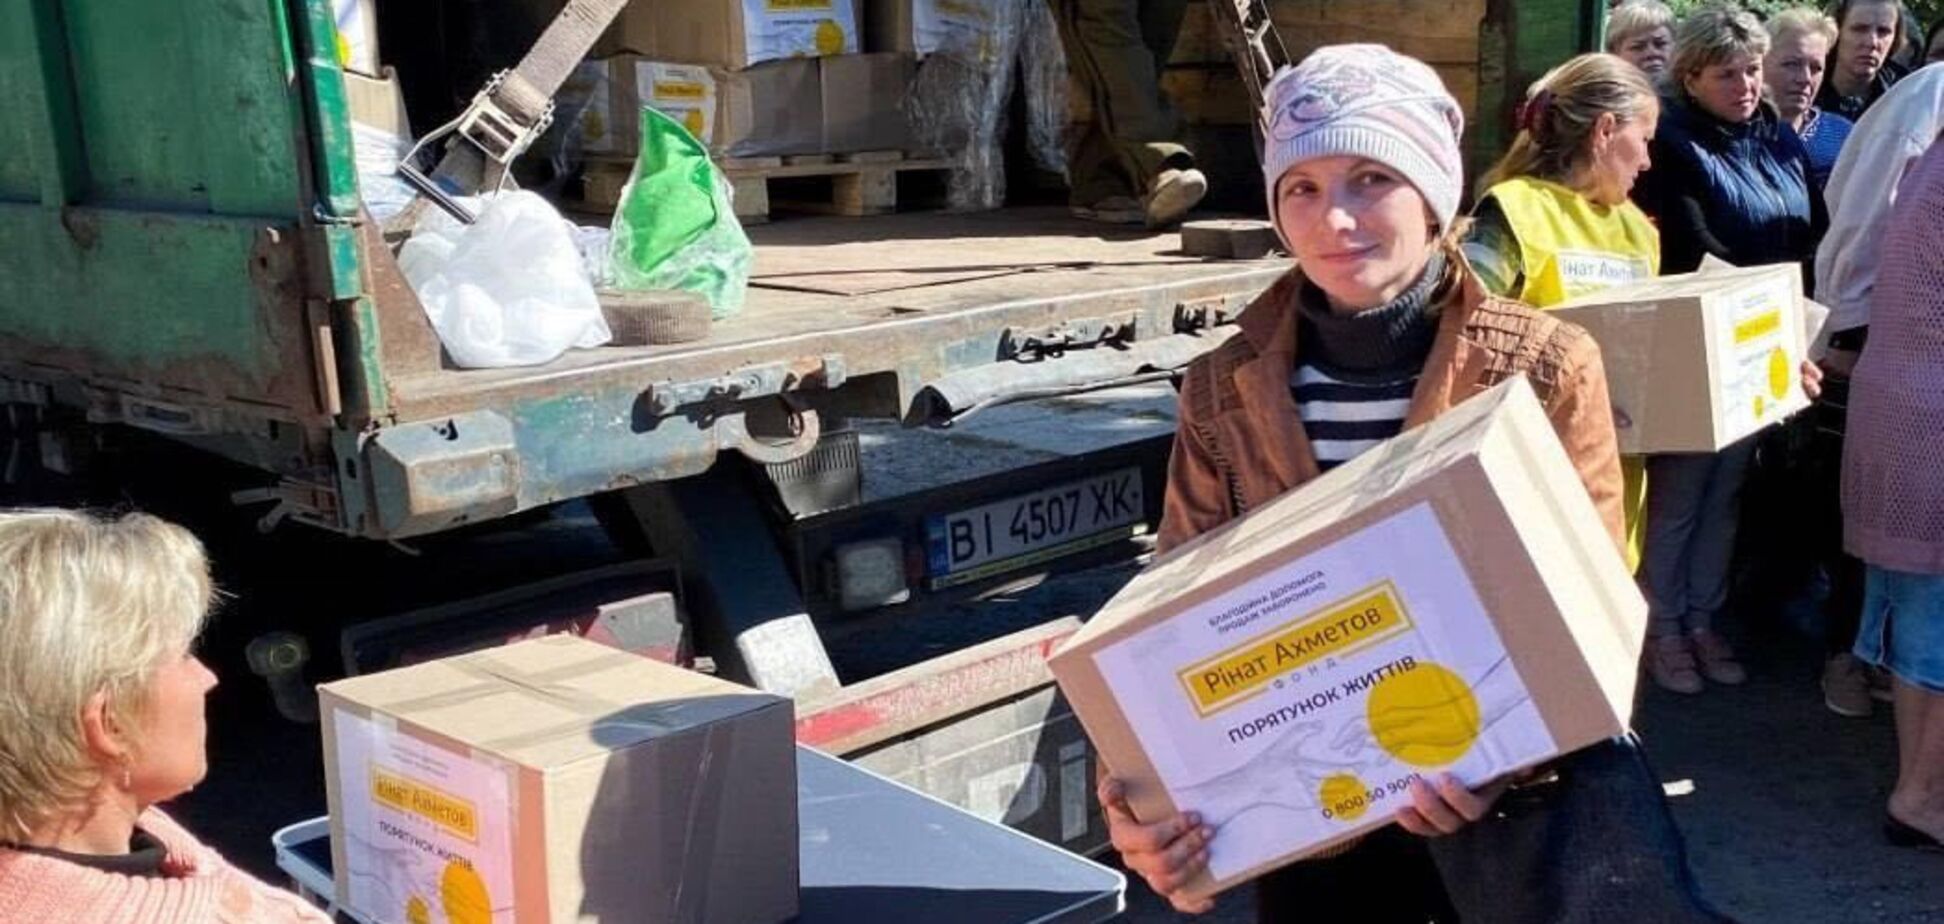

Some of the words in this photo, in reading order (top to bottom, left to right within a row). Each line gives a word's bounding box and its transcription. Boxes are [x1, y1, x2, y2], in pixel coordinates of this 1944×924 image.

[950, 511, 993, 563] BI
[1009, 489, 1081, 545] 4507
[1091, 474, 1133, 524] XK
[1218, 610, 1260, 634] ПРОДАЖ
[1261, 582, 1327, 615] ЗАБОРОНЕНО
[1269, 570, 1325, 601] ДОПОМОГА
[1203, 655, 1267, 694] Рінат
[1274, 606, 1382, 665] Ахметов
[1227, 686, 1341, 744] ПОРЯТУНОК
[1341, 654, 1418, 697] ЖИТТІВ
[1321, 807, 1333, 820] 0
[1335, 795, 1365, 815] 800
[1365, 786, 1385, 803] 50
